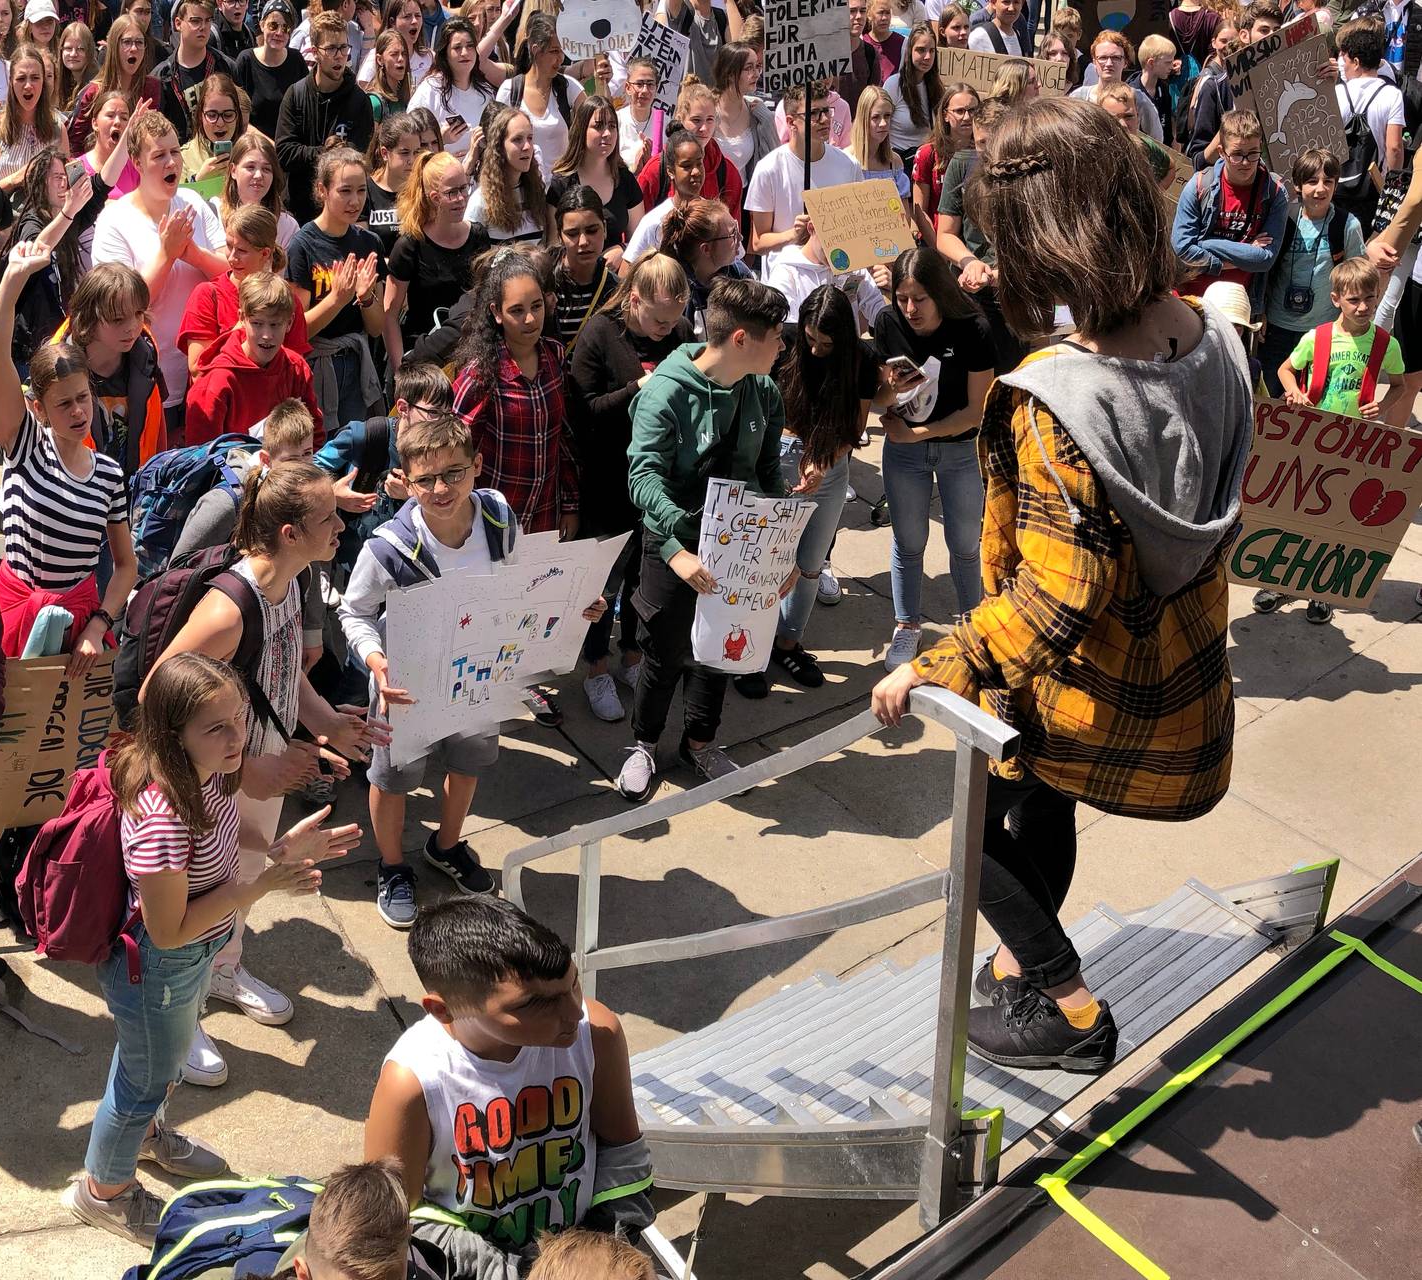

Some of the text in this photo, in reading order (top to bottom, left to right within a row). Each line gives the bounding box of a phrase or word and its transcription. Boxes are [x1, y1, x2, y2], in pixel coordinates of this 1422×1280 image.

[765, 24, 799, 51] FÜR
[765, 43, 817, 72] KLIMA
[765, 58, 850, 93] IGNORANZ
[371, 211, 394, 223] JUST
[1242, 455, 1351, 516] UNS
[699, 549, 723, 569] MY
[1231, 528, 1392, 598] GEHÖRT
[24, 768, 66, 808] DIE
[455, 1075, 584, 1159] GOOD
